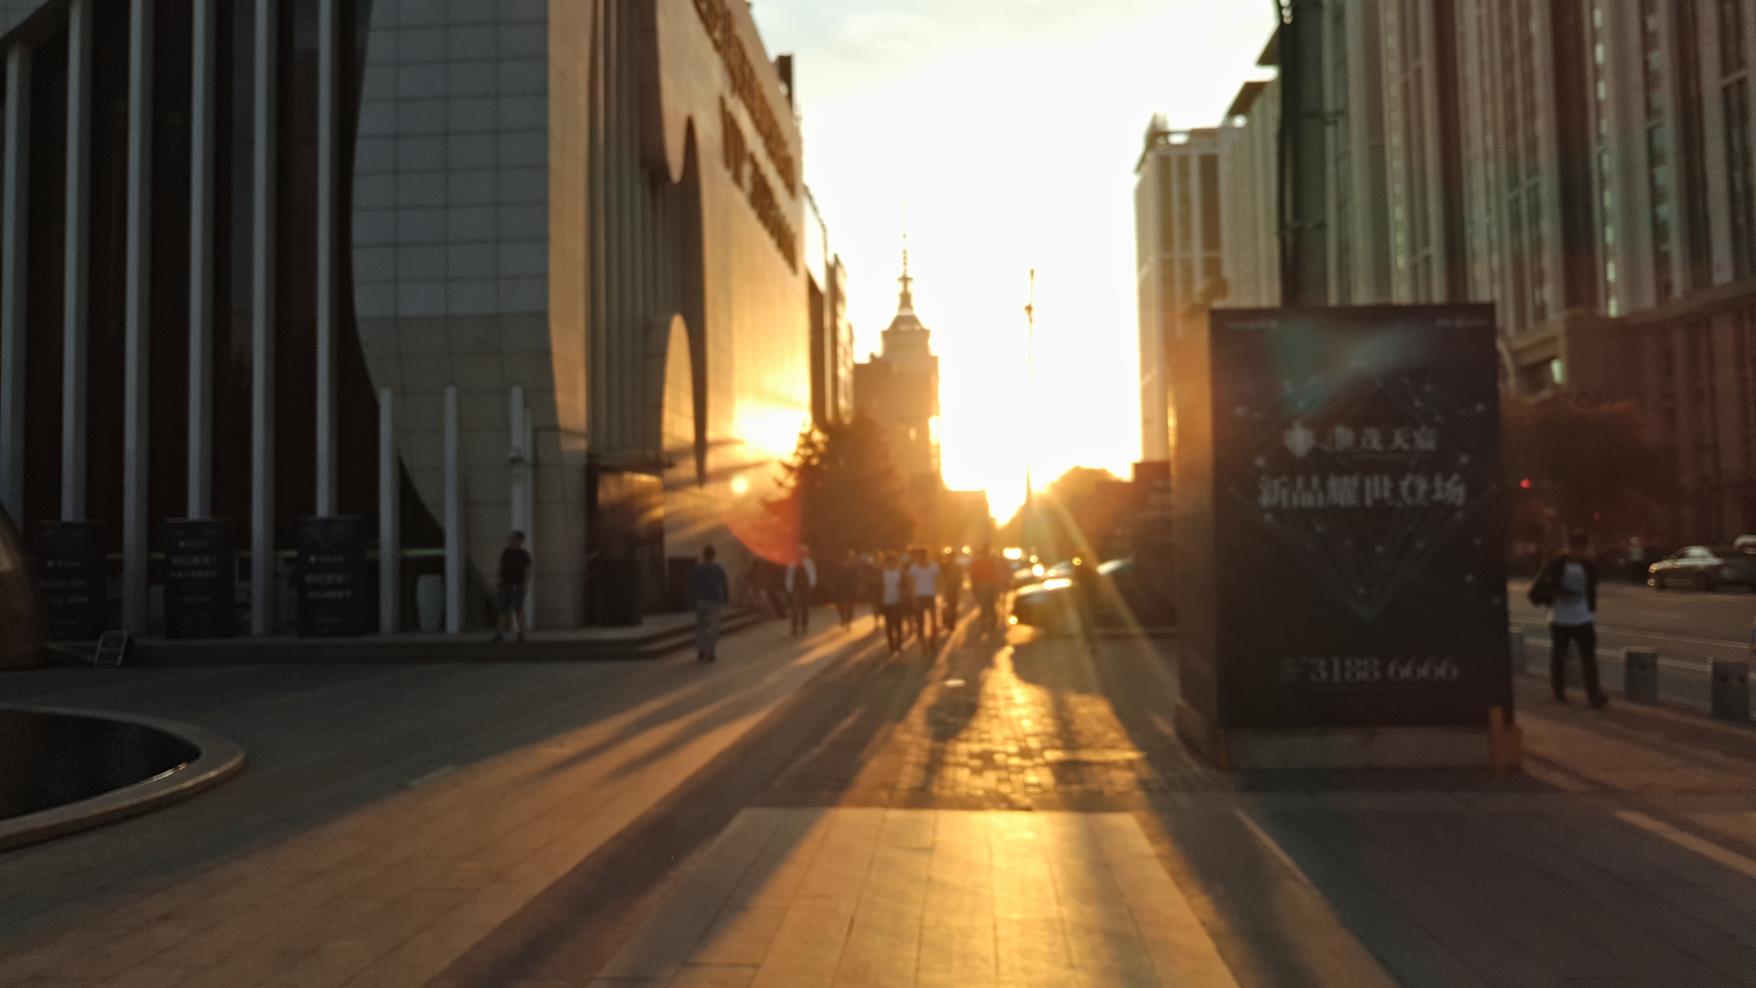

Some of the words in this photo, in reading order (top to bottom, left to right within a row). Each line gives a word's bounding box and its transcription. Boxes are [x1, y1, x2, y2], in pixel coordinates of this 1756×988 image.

[1257, 473, 1466, 507] 新品耀世登场
[1308, 656, 1381, 682] 3188
[1386, 656, 1461, 682] 6666
